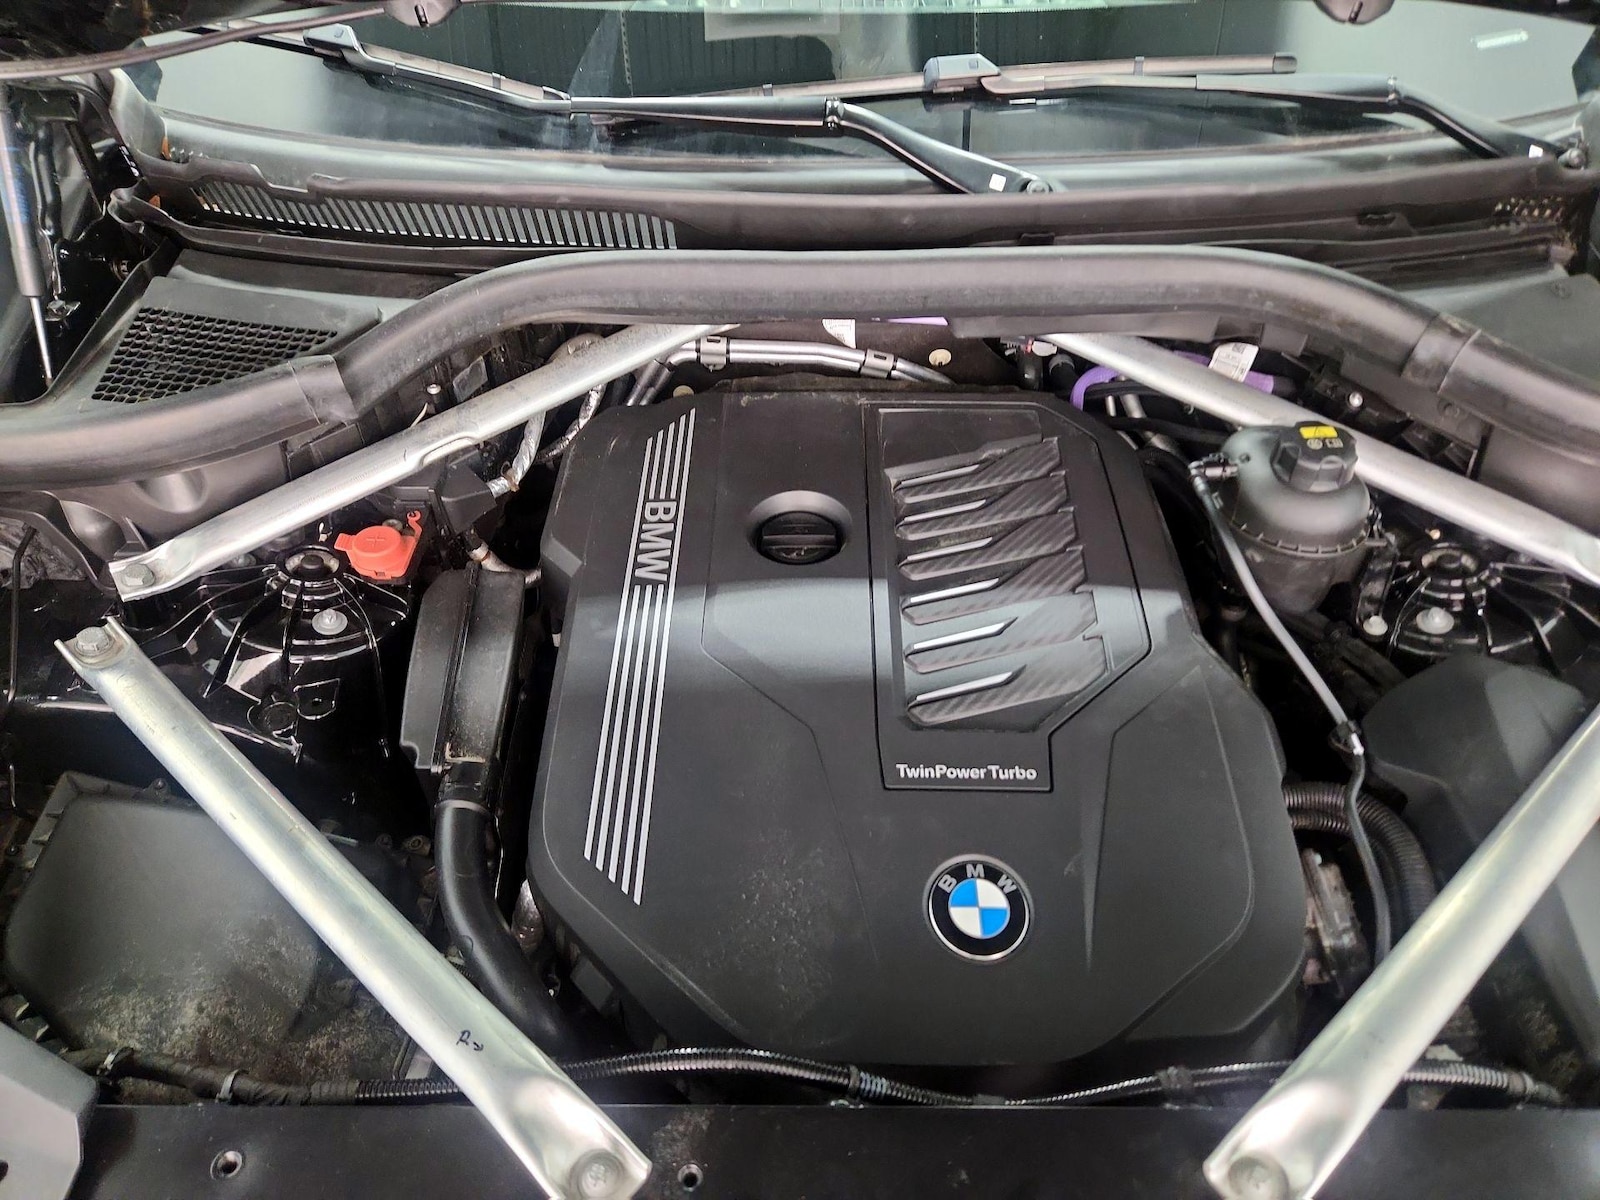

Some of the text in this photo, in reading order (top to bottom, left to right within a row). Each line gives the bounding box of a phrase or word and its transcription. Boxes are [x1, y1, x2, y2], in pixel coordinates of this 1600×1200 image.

[634, 501, 677, 581] BMW
[895, 763, 1038, 780] TwinPower Turbo
[937, 863, 1017, 894] BMW
